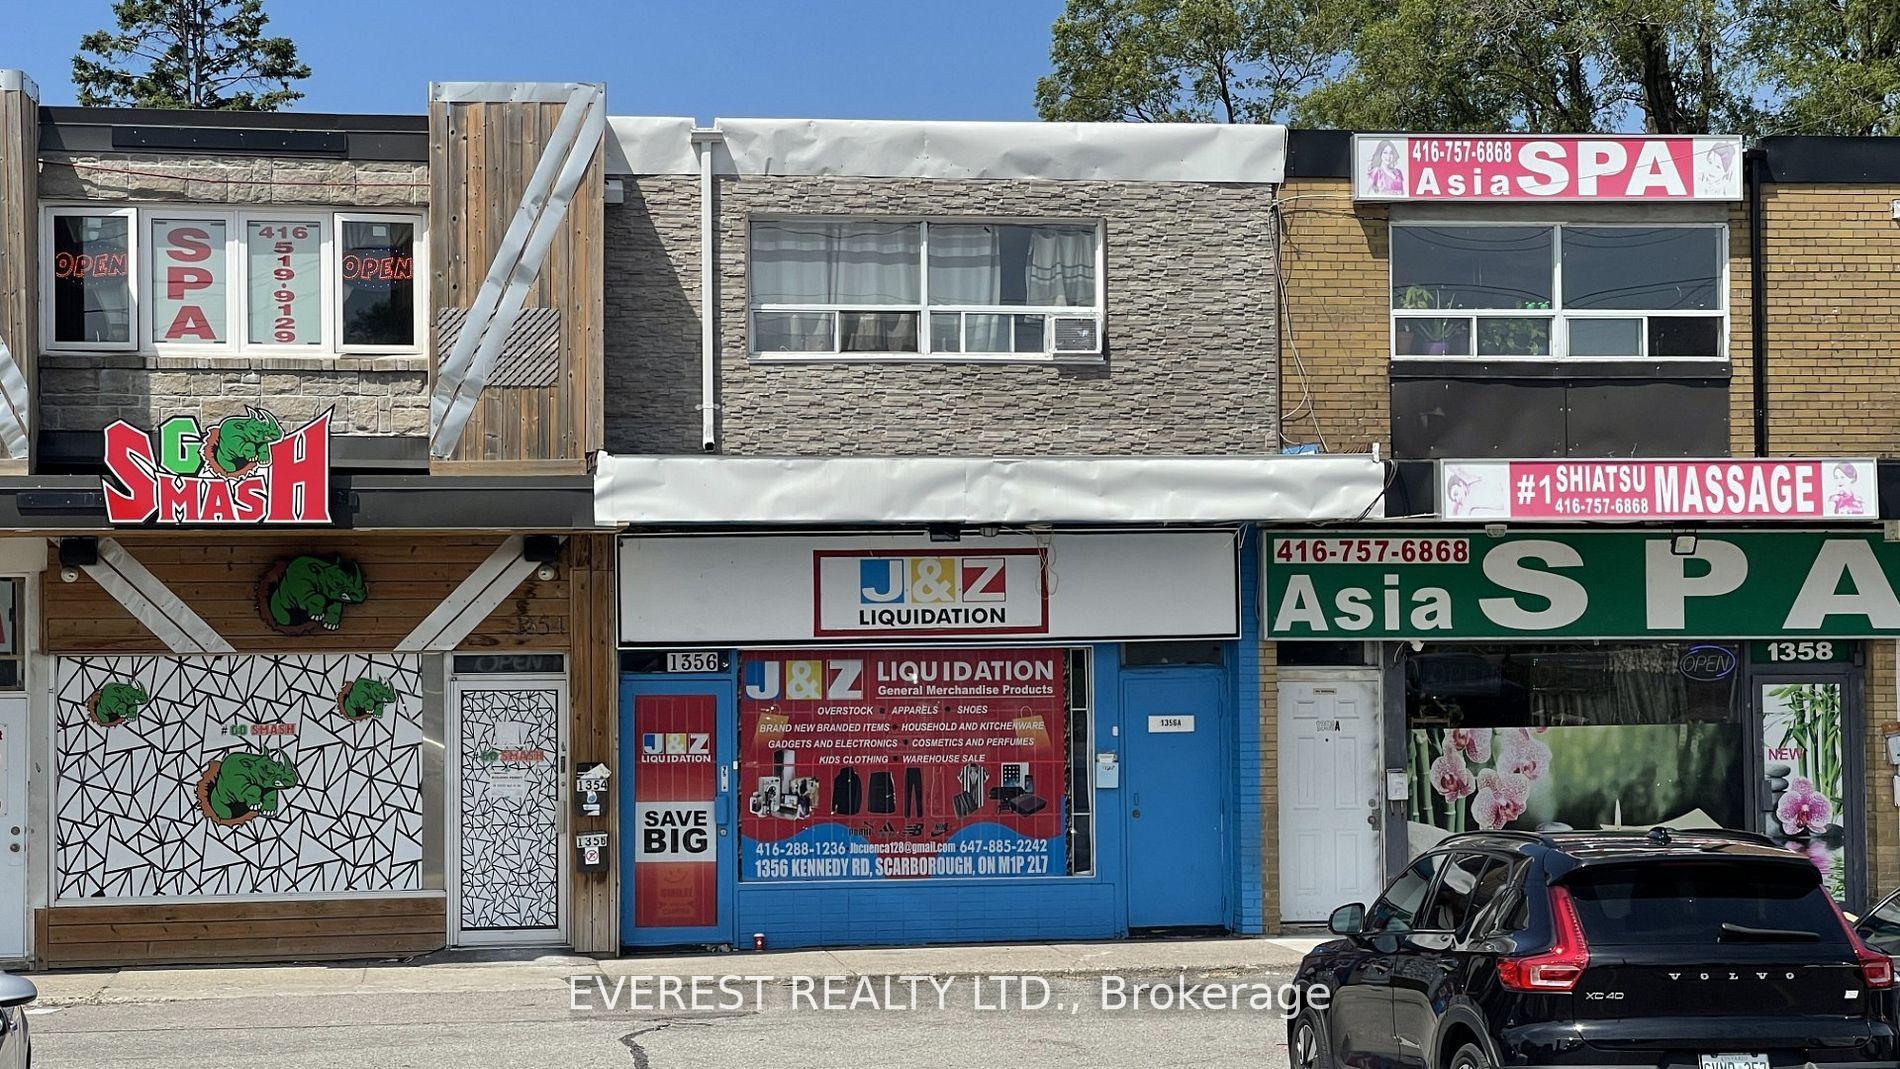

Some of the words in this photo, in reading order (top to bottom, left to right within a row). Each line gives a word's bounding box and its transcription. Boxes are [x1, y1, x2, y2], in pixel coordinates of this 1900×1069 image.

[1413, 141, 1512, 162] 416-757-6868
[1415, 168, 1511, 195] Asia
[1516, 141, 1687, 196] SPA
[259, 227, 308, 239] 416
[55, 251, 128, 278] OPEN
[342, 254, 412, 280] OPEN
[165, 228, 216, 340] SPA
[102, 405, 334, 525] SMASH
[1517, 475, 1551, 505] #1
[1555, 465, 1646, 492] SHIATSU
[1654, 465, 1815, 514] MASSAGE
[1555, 498, 1649, 514] 416-757-6868
[1276, 540, 1468, 562] 416-757-6868
[861, 558, 1006, 603] J&Z
[1273, 574, 1453, 631] Asia
[1478, 539, 1900, 631] SPA
[859, 608, 1006, 626] LIQUIDATION
[1767, 642, 1833, 661] 1358
[669, 653, 718, 671] 1356
[1682, 655, 1730, 672] OPEN
[745, 659, 863, 700] J&Z
[877, 660, 1053, 682] LIQUIDATION
[878, 685, 922, 696] General
[926, 685, 999, 696] Merchandise
[1002, 684, 1053, 694] Products
[817, 706, 873, 715] OVERSTOCK
[891, 705, 939, 714] APPARELS
[957, 705, 988, 714] SHOES
[759, 723, 792, 732] BRAND
[794, 723, 815, 732] NEW
[817, 723, 861, 732] BRANDED
[862, 723, 890, 732] ITEMS
[901, 722, 957, 731] HOUSEHOLD
[958, 722, 978, 730] AND
[979, 721, 1045, 730] KITCHENWARE
[642, 733, 710, 754] J&Z
[768, 740, 812, 748] GADGETS
[813, 740, 833, 748] AND
[835, 739, 898, 748] ELECTRONICS
[912, 739, 963, 747] COSMETICS
[965, 738, 984, 746] AND
[986, 738, 1035, 746] PERFUMES
[641, 755, 711, 763] LIQUIDATION
[819, 756, 841, 764] KIDS
[842, 755, 888, 763] CLOTHING
[902, 754, 960, 763] WAREHOUSE
[961, 754, 986, 762] SALE
[1768, 748, 1805, 760] NEW
[578, 780, 607, 791] 1354
[644, 810, 708, 826] SAVE
[643, 828, 708, 854] BIG
[755, 842, 846, 856] 416-288-1236
[959, 839, 1048, 853] 647-885-2242
[755, 859, 788, 877] 1356
[791, 858, 849, 877] KENNEDY
[852, 857, 873, 877] RD,
[875, 856, 976, 876] SCARBOROUGH,
[978, 856, 996, 875] ON
[998, 855, 1025, 874] M1P
[1027, 855, 1048, 874] 2L7
[1668, 972, 1795, 981] VOLVO
[1585, 991, 1625, 1000] XC40
